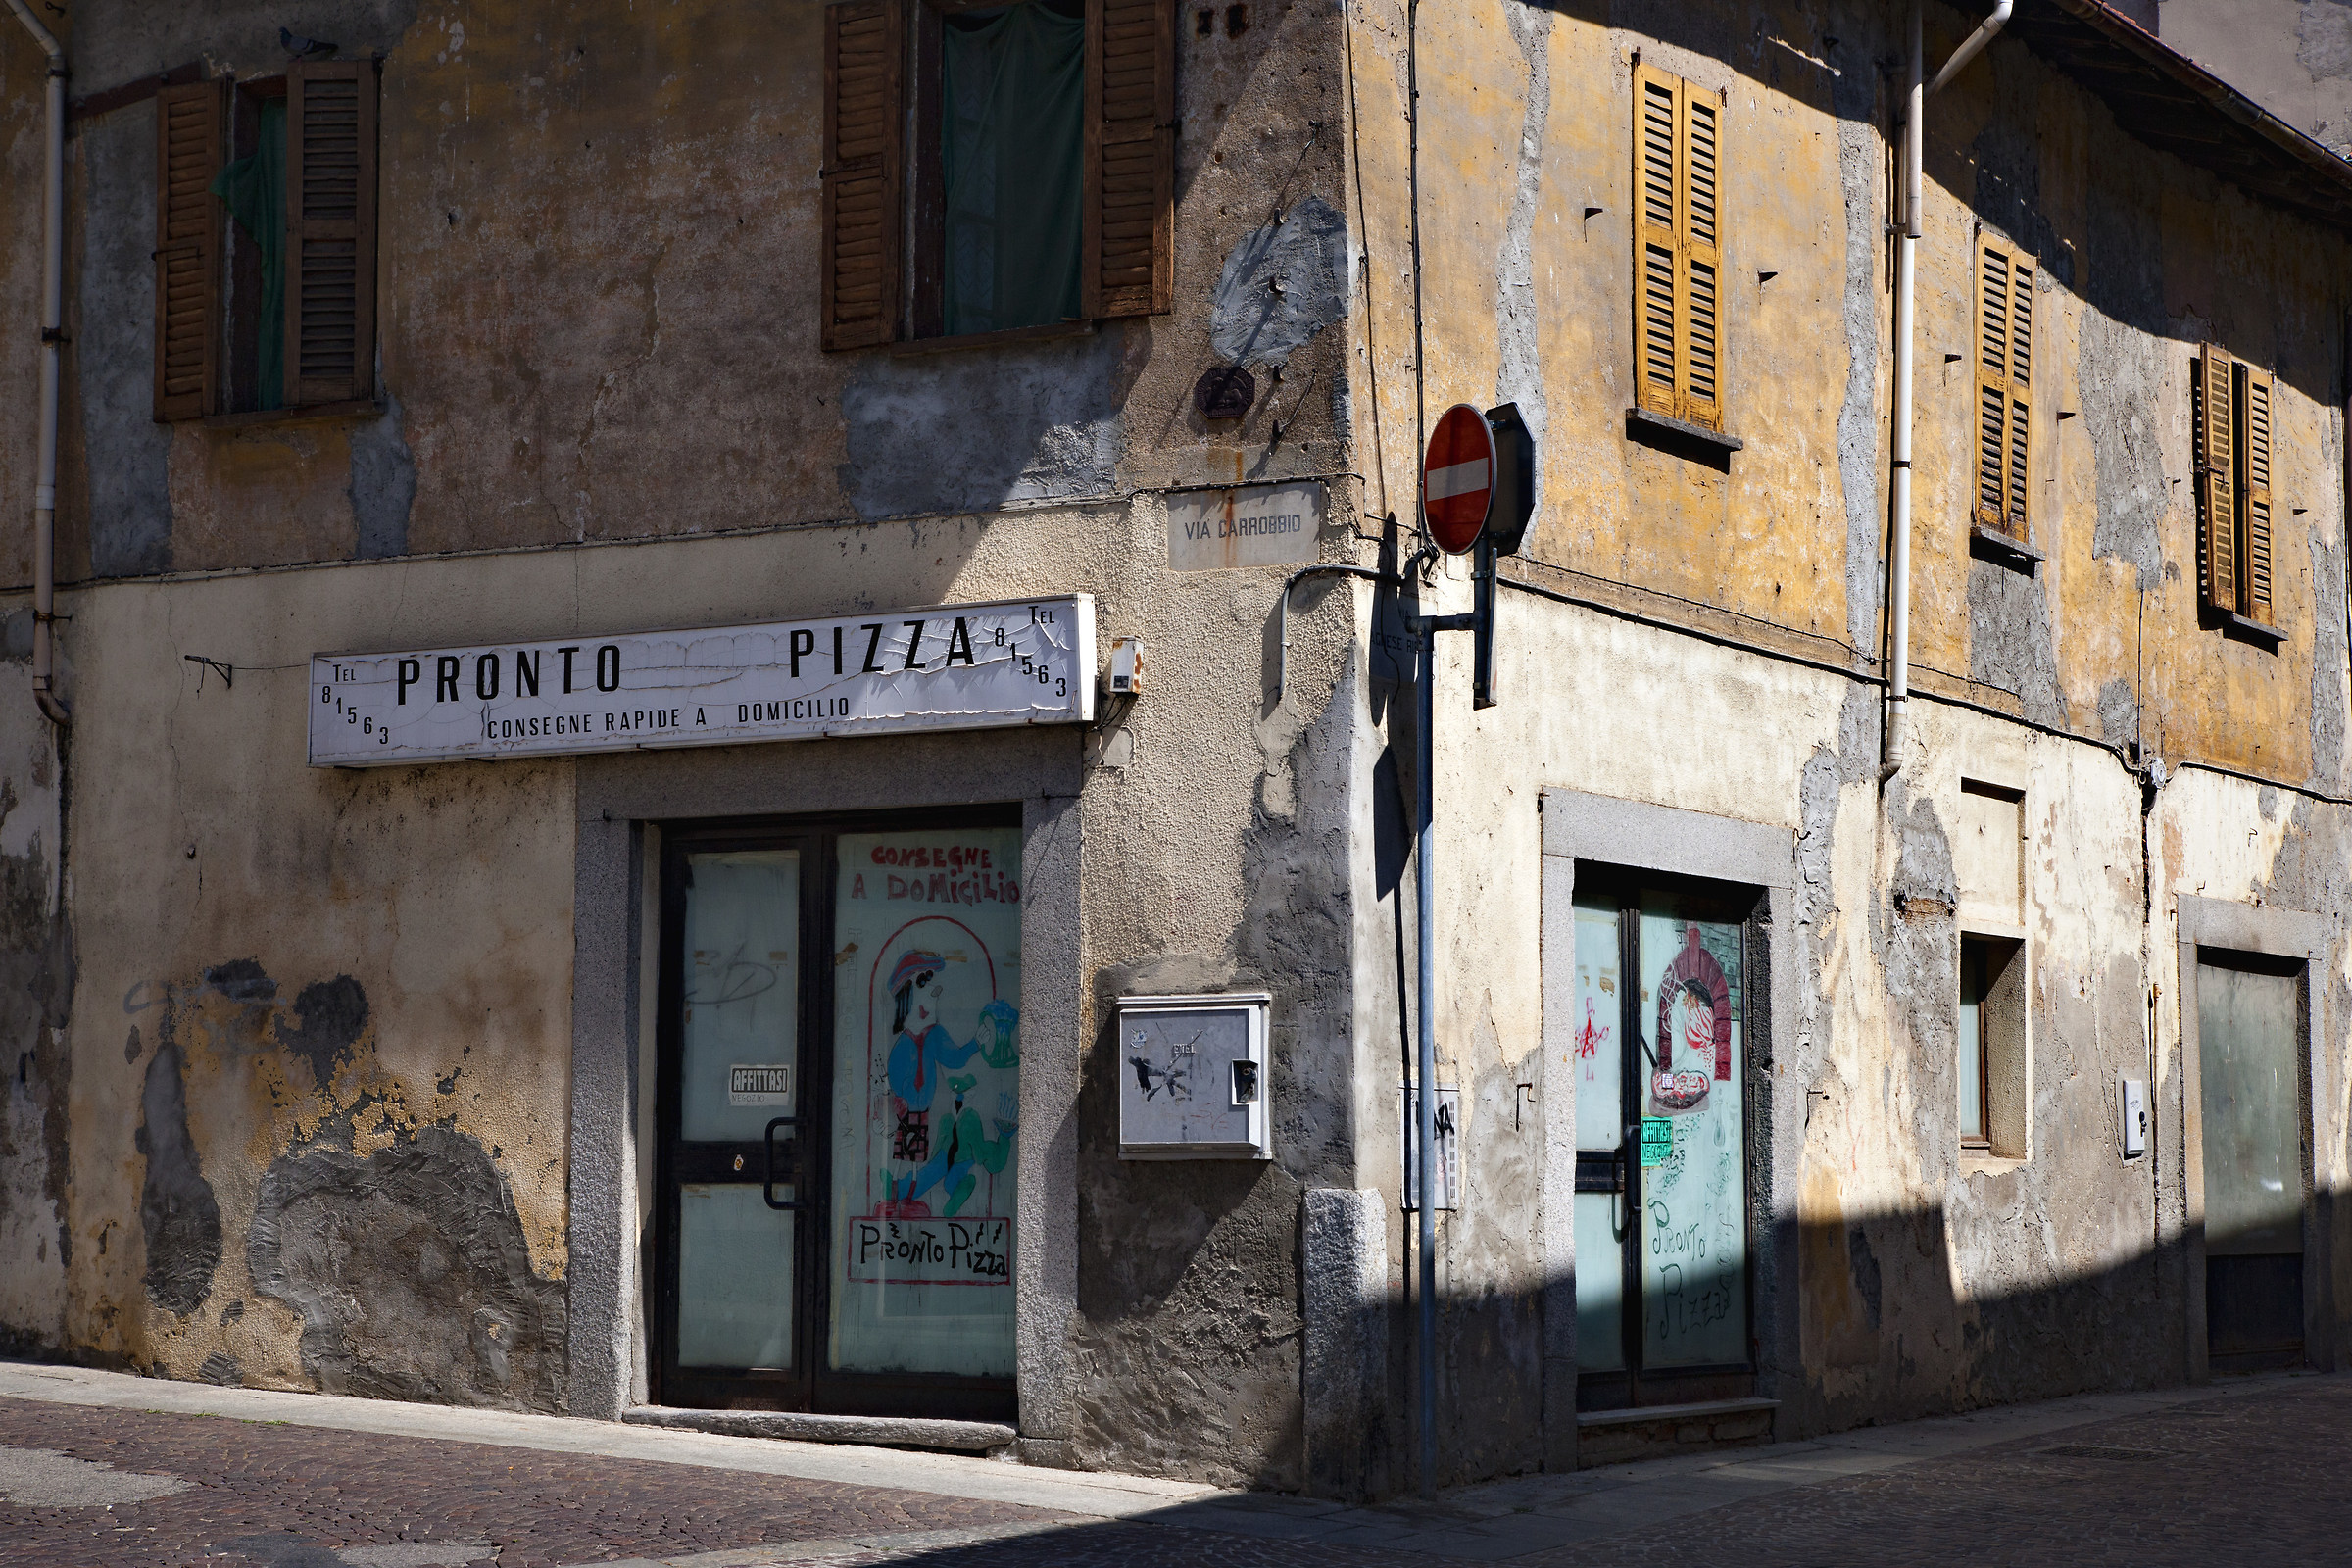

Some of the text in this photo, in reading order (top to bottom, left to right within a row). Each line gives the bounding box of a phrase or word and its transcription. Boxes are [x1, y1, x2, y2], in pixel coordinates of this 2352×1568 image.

[1185, 514, 1301, 540] VIA CARROBBIO
[1028, 606, 1055, 625] TEL
[332, 663, 357, 683] TEL
[397, 616, 975, 707] PRONTO PIZZA
[487, 697, 850, 740] CONSEGNE RAPIDE A DOMICILIO
[870, 845, 993, 873] CONSEGNE
[852, 873, 868, 900] A
[733, 1069, 787, 1091] AFFITTASI
